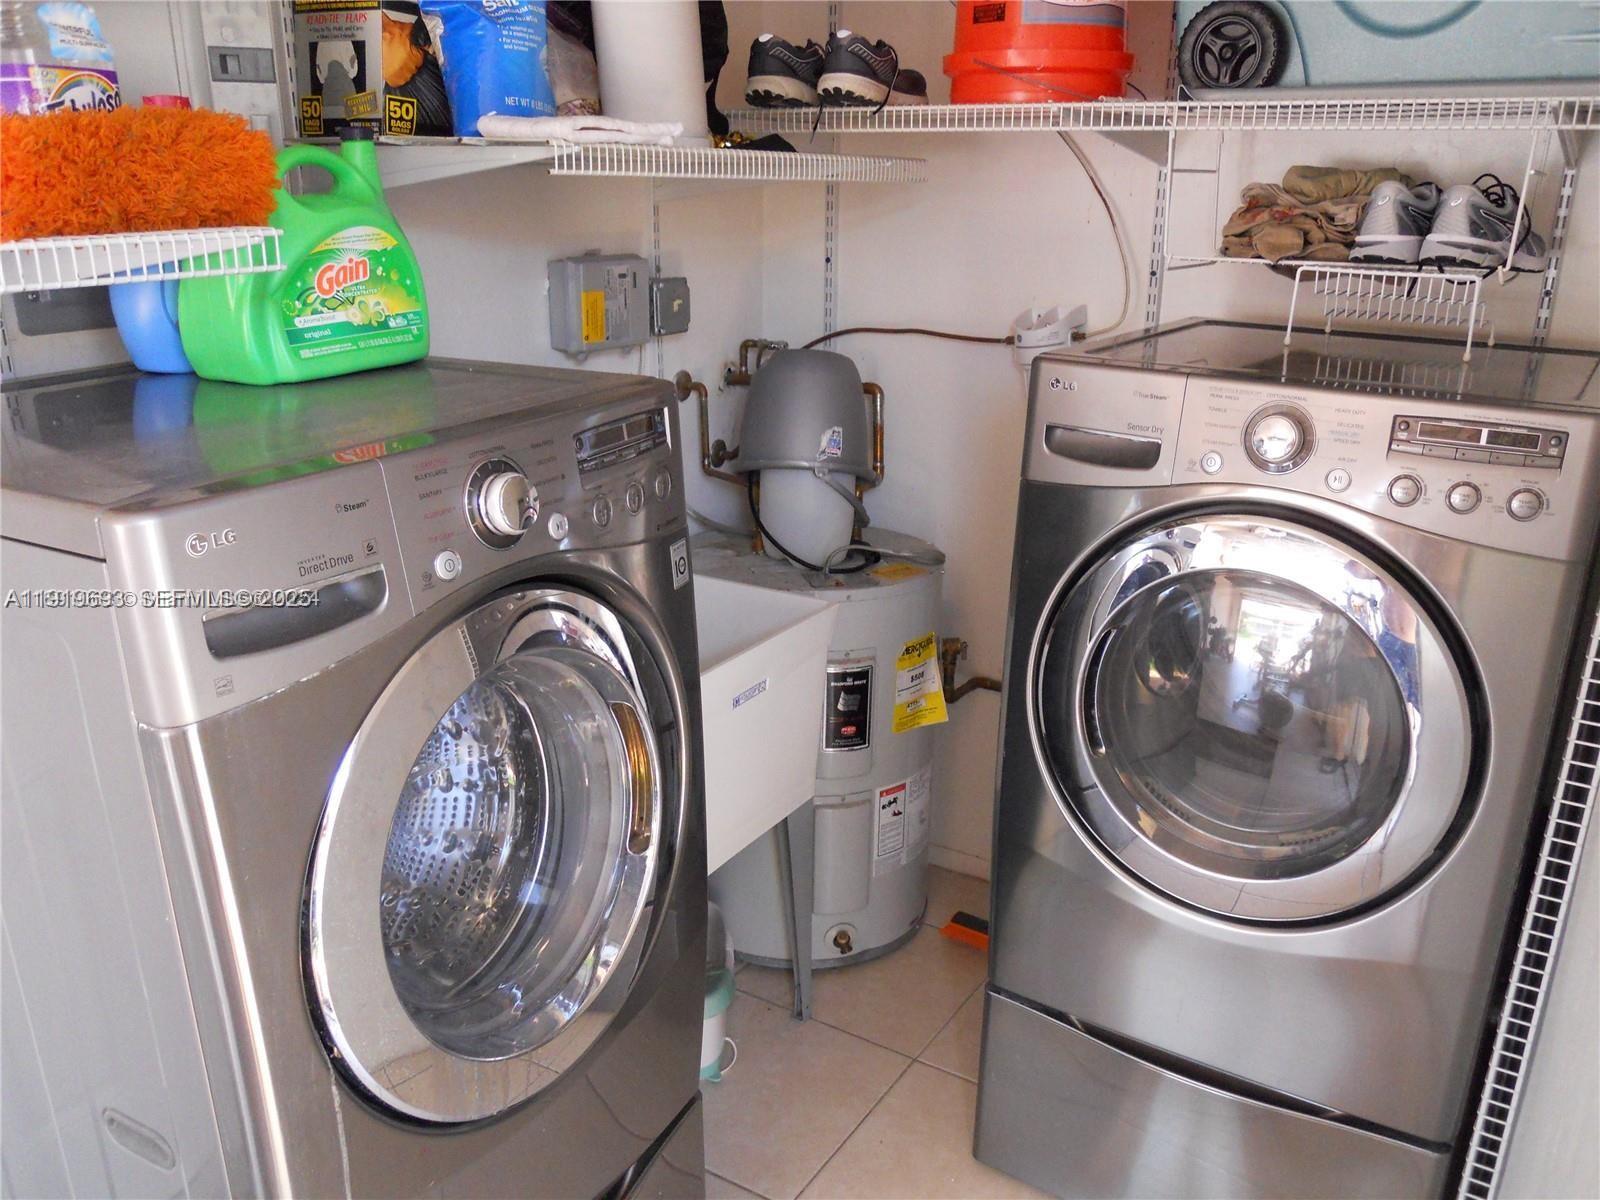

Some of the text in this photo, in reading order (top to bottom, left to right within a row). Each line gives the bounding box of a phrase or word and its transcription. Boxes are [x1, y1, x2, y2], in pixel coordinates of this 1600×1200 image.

[302, 101, 320, 118] 50
[389, 101, 414, 120] 50
[390, 120, 412, 129] BAGS
[315, 256, 368, 297] Gain
[1127, 421, 1165, 435] Sensor Dry
[343, 500, 367, 512] Steam
[210, 527, 240, 549] LG
[298, 553, 355, 577] Direct Drive
